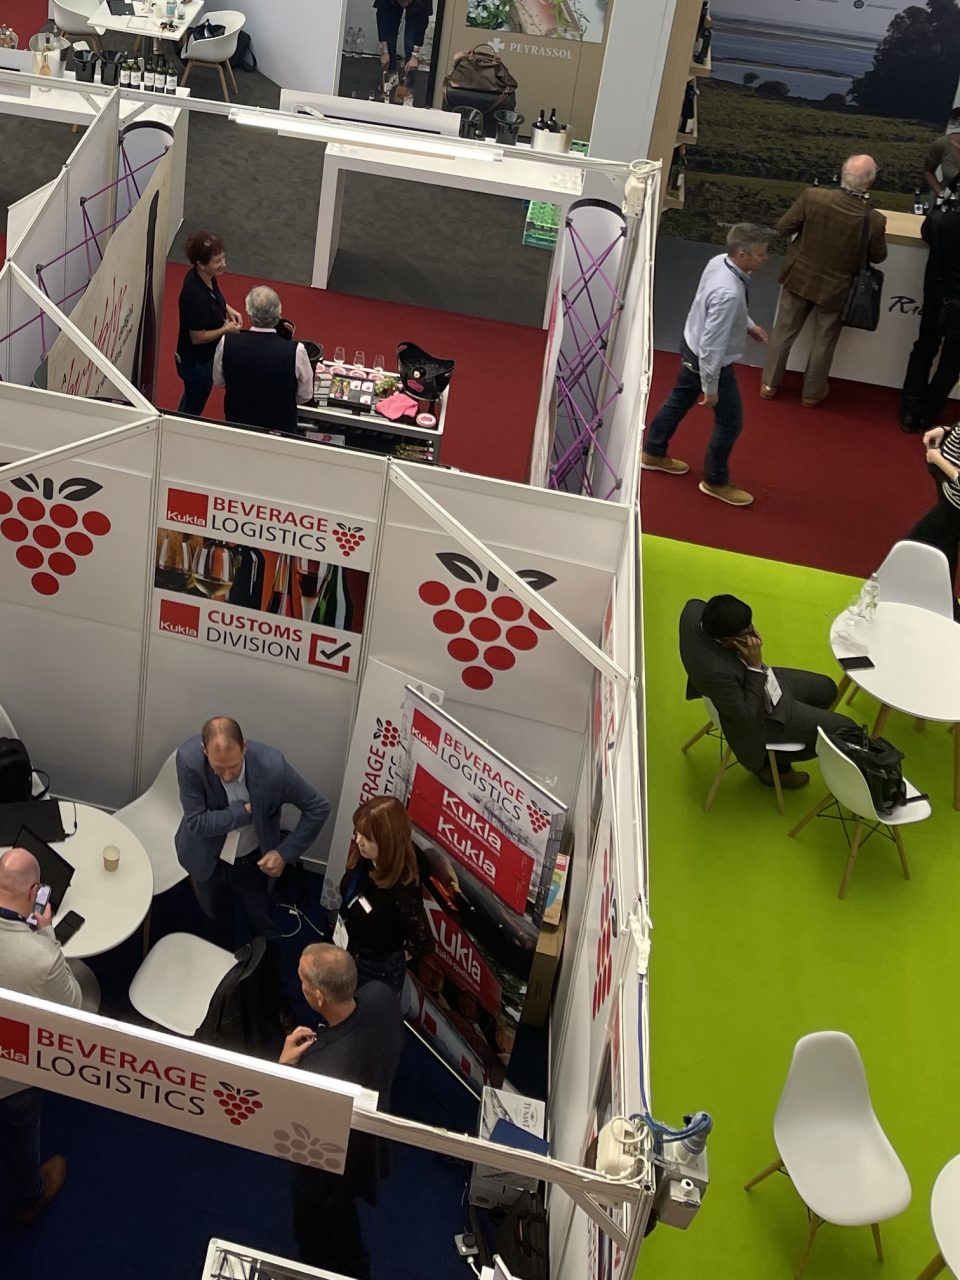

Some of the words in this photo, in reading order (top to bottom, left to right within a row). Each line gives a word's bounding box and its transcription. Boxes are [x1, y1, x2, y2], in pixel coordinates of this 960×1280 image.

[509, 42, 573, 60] PEYRASSOL
[167, 511, 206, 527] Kukla
[211, 514, 327, 553] LOGISTICS
[213, 496, 329, 534] BEVERAGE
[160, 621, 197, 637] Kukla
[206, 627, 301, 662] DIVISION
[207, 610, 303, 643] CUSTOMS
[358, 745, 386, 803] ERAGE
[411, 726, 438, 754] Kukla
[444, 732, 525, 806] BEVERAGE
[441, 747, 521, 822] LOGISTICS
[437, 815, 497, 878] Kukla
[443, 789, 502, 852] Kukla
[36, 1050, 205, 1116] LOGISTICS
[37, 1027, 207, 1093] BEVERAGE
